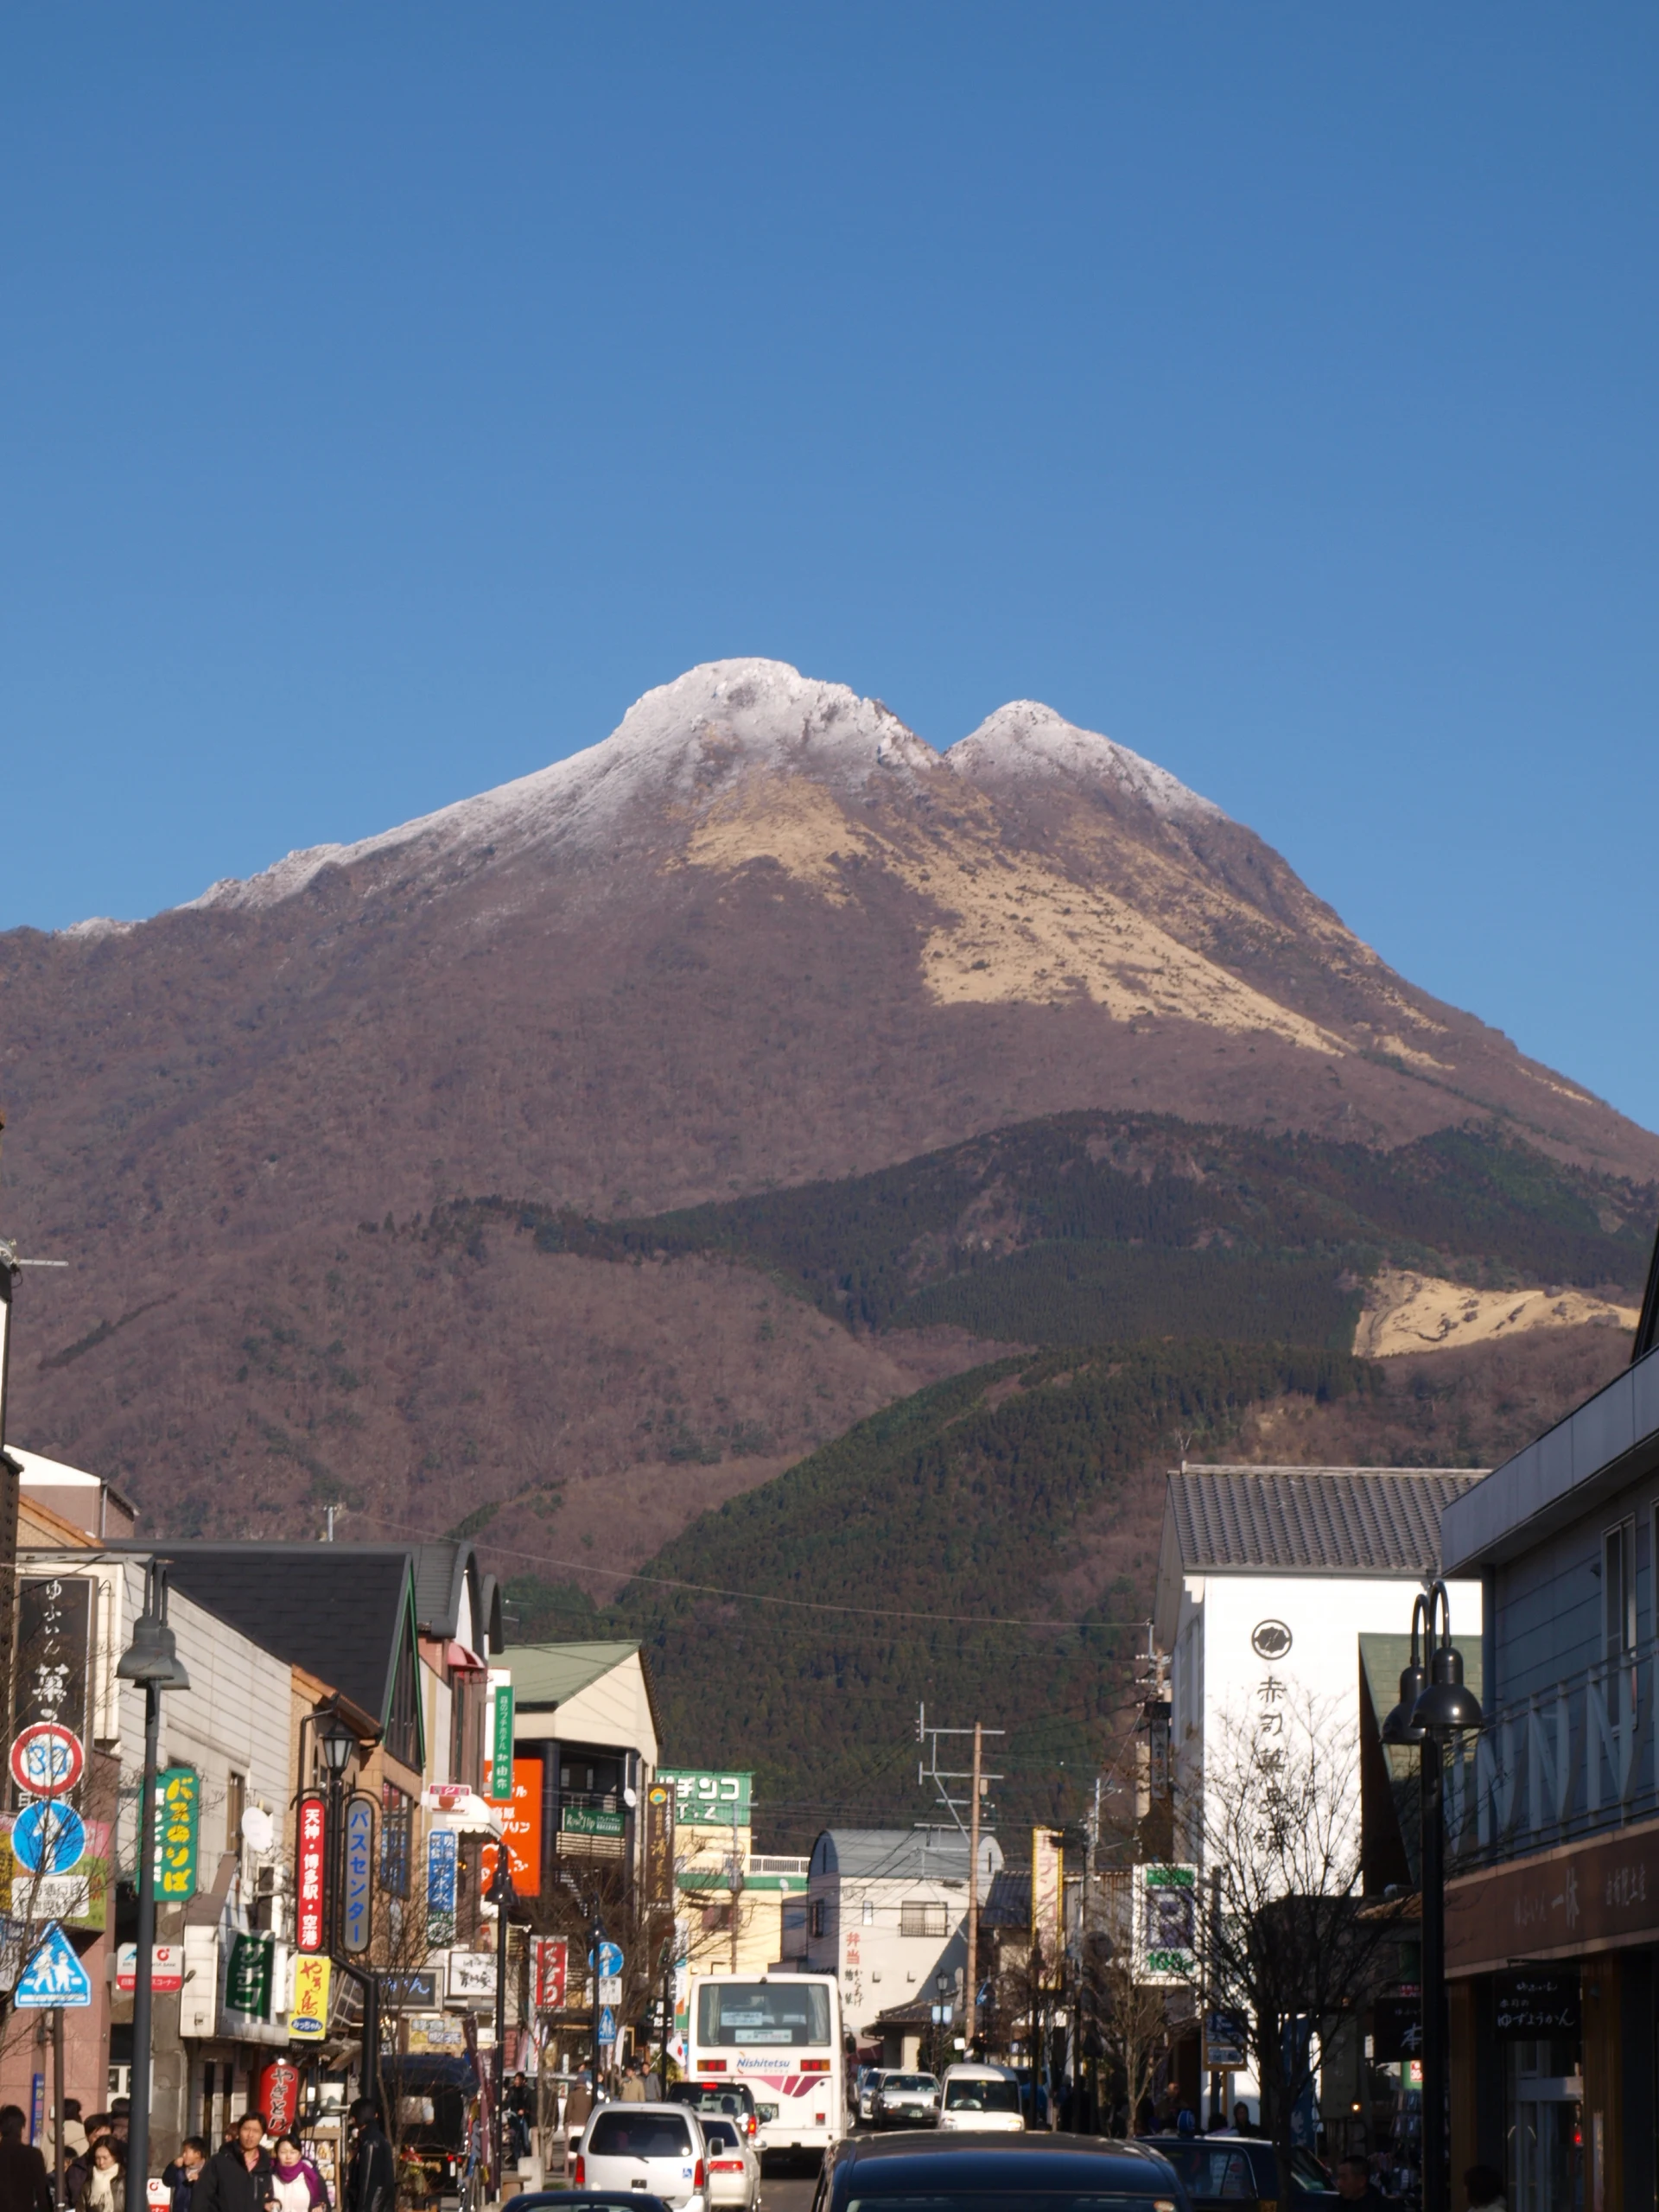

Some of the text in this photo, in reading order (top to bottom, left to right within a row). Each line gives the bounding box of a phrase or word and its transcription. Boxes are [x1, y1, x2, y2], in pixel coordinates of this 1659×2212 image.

[29, 1745, 67, 1776] 30
[163, 1777, 193, 1892] バスのりば
[302, 1808, 321, 1946] 天神・博多駅・空港
[348, 1810, 369, 1943] バスセンター
[1150, 1892, 1187, 1944] P
[846, 1932, 861, 1964] 弁当
[296, 1961, 322, 2017] やき鳥
[1497, 2008, 1576, 2029] ゆずようかん
[737, 2058, 790, 2068] Nishitetsu
[269, 2068, 294, 2132] やきとり
